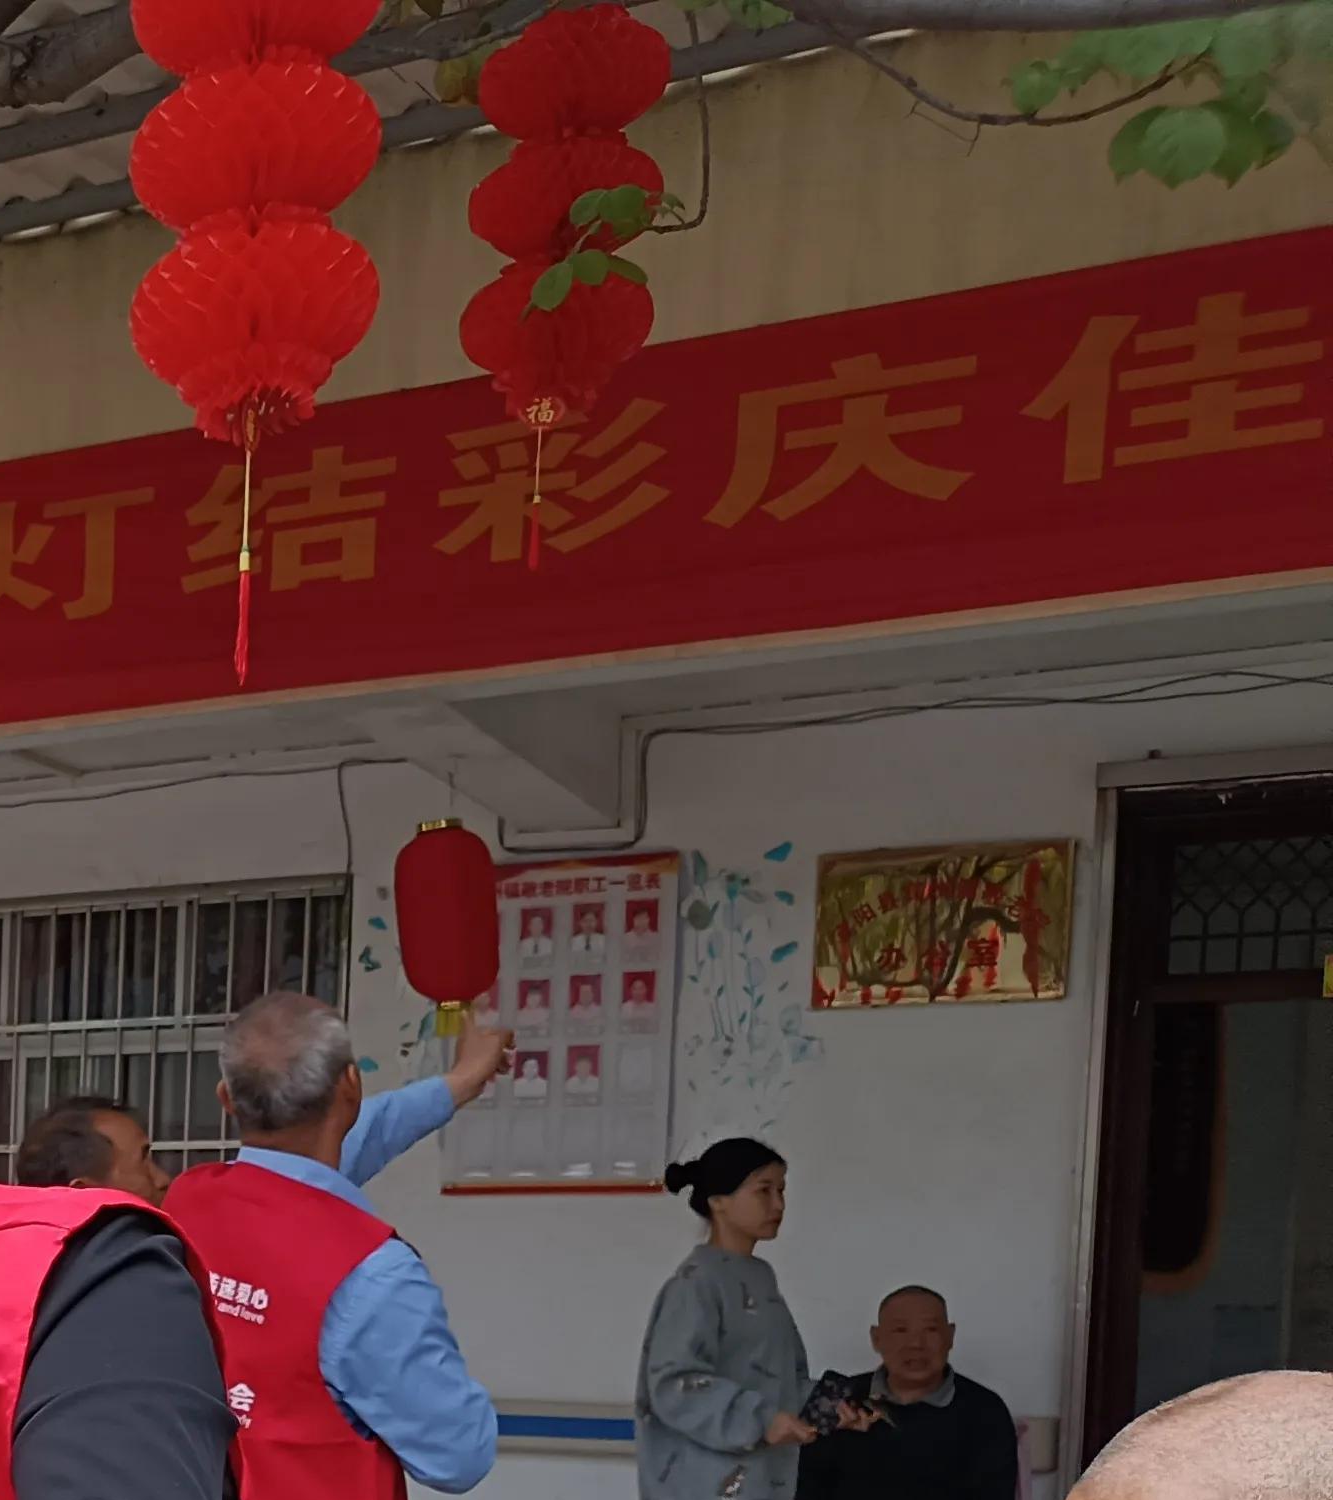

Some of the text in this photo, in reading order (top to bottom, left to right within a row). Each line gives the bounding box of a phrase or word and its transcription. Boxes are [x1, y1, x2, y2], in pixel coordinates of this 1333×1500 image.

[526, 397, 554, 424] 福
[217, 1302, 265, 1325] and love
